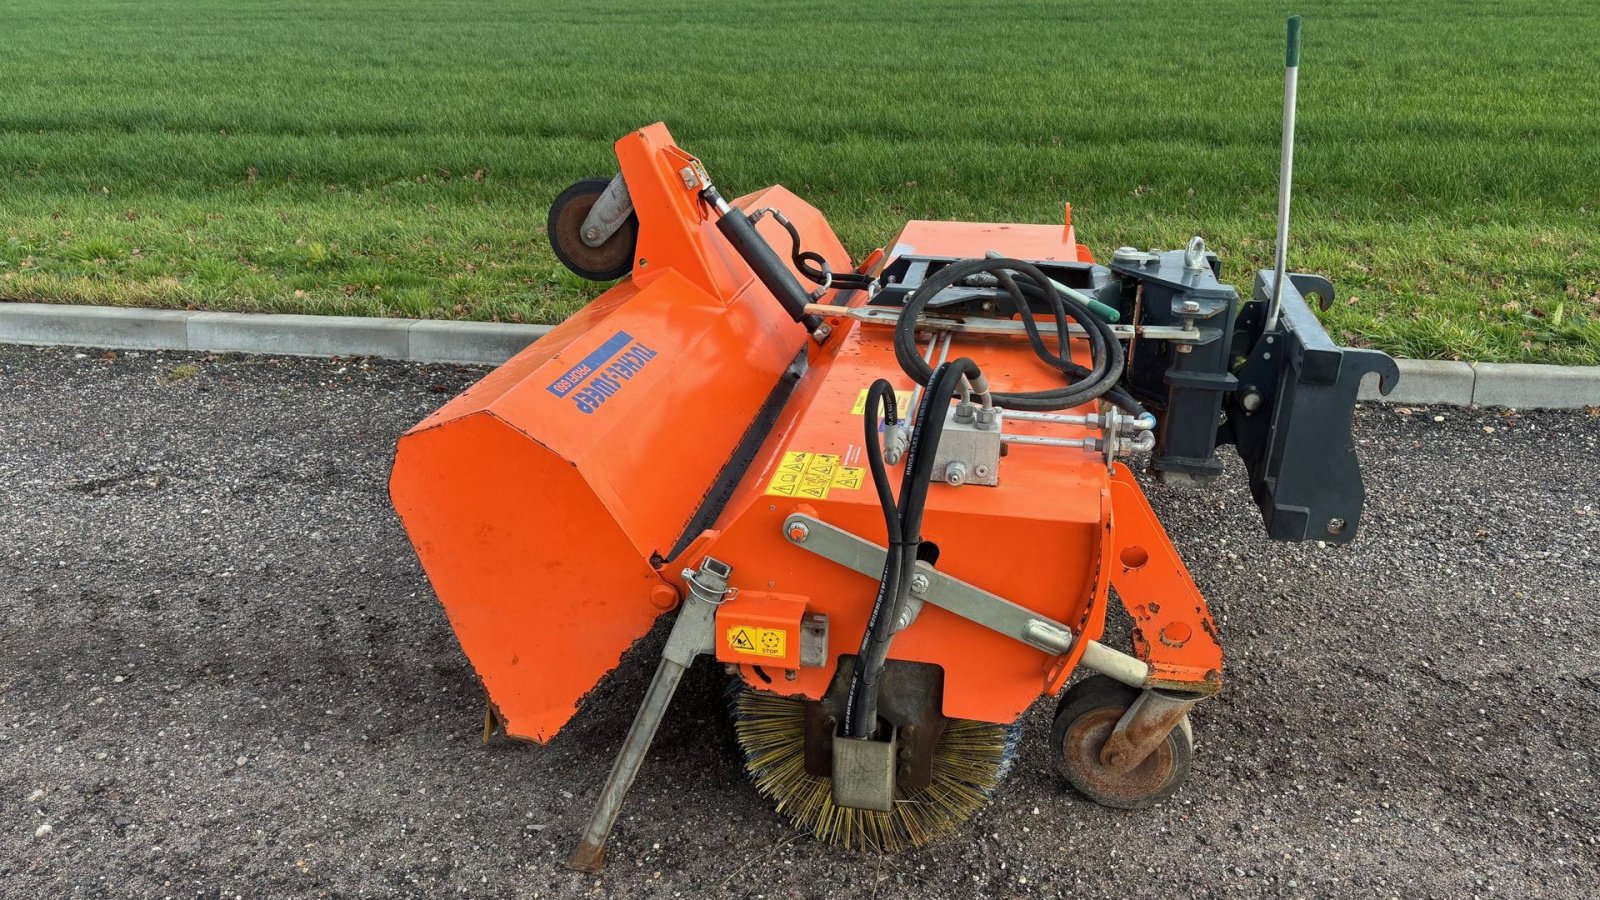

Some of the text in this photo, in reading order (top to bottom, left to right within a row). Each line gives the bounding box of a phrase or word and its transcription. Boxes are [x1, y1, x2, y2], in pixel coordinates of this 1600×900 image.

[553, 363, 592, 394] PROFI 660
[571, 342, 658, 415] TUCHEL-SWEEP
